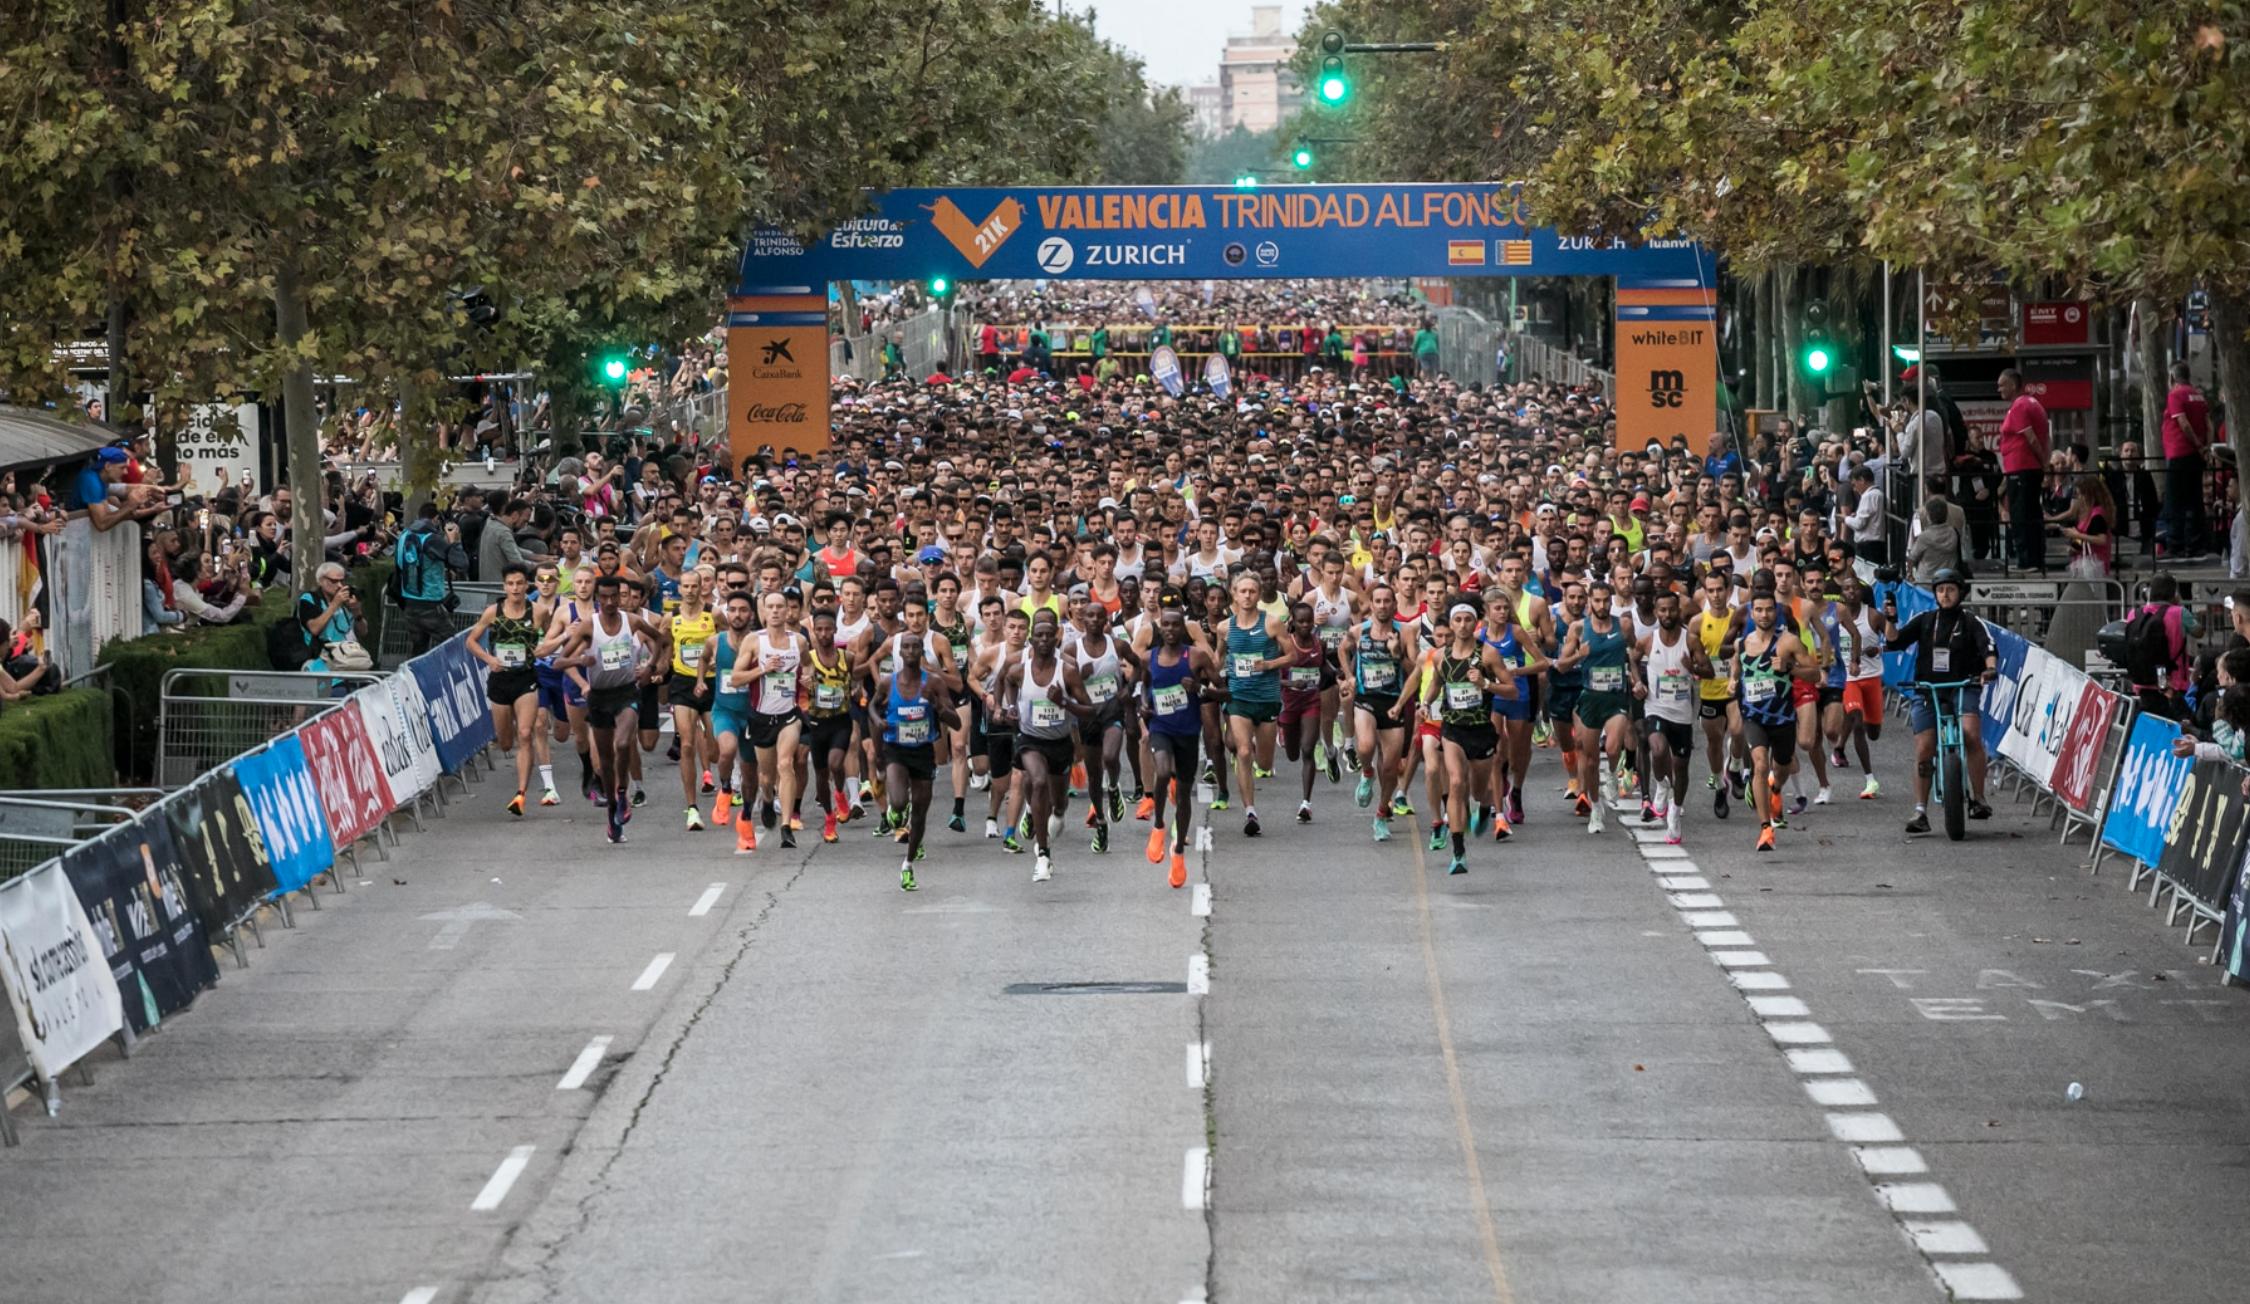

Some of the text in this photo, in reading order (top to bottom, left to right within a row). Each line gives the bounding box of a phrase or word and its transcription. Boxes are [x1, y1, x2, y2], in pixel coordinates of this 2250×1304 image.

[1038, 194, 1206, 229] VALENCIA
[1216, 193, 1370, 228] TRINIDAD
[831, 232, 904, 248] Esfuerzo
[974, 214, 1009, 255] 21K
[754, 247, 804, 256] ALFONSO
[1085, 242, 1186, 266] ZURICH
[1632, 330, 1704, 345] whiteBIT
[752, 368, 802, 379] CaixaBank
[199, 444, 240, 459] más
